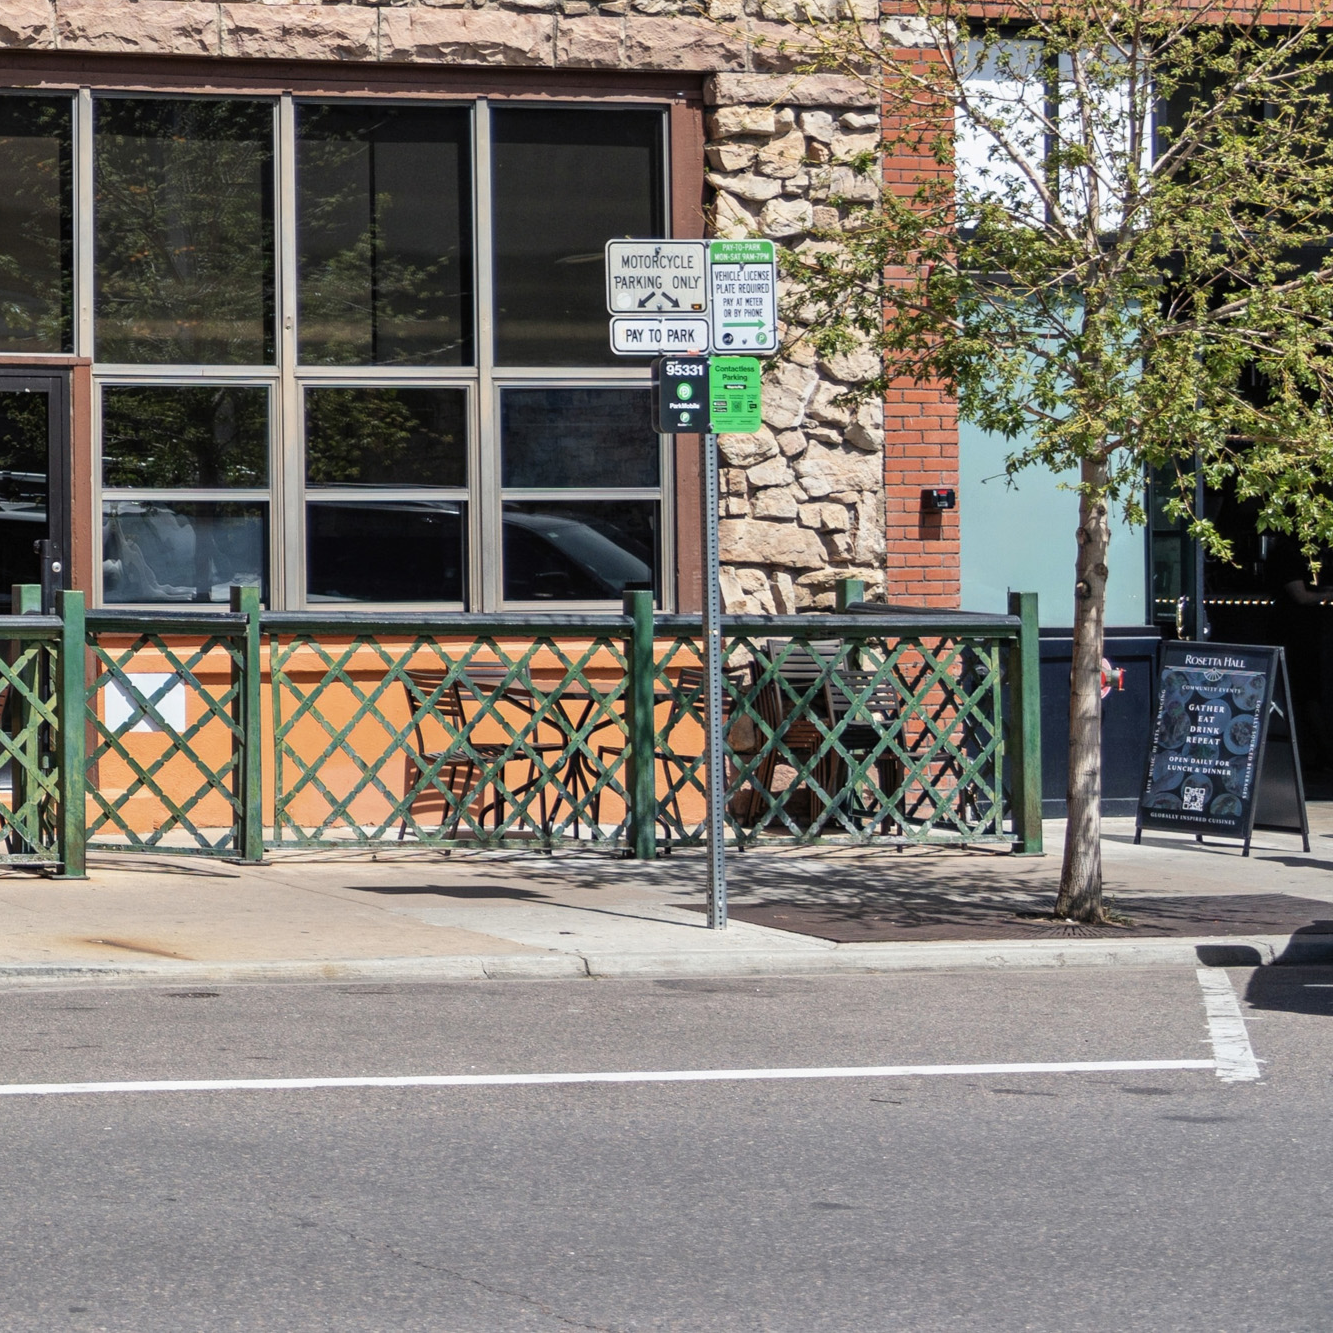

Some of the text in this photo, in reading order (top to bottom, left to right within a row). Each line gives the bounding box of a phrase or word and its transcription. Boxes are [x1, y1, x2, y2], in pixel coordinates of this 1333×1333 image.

[621, 255, 694, 269] MOTORCYCLE
[714, 270, 770, 282] VEHICLE LICENSE
[614, 276, 701, 290] PARKING ONLY
[716, 283, 770, 294] PLATE REQUIRED
[723, 298, 763, 307] PAY AT METER
[723, 309, 763, 318] OR BY PHONE
[625, 329, 695, 343] PAY TO PARK
[666, 364, 703, 376] 95331
[715, 365, 755, 373] Contactless
[722, 374, 748, 382] Parking
[1185, 654, 1246, 668] ROSETTA HALL
[1182, 684, 1217, 692] COMMUNITY
[1158, 689, 1166, 719] DANCING
[1188, 703, 1225, 713] GATHER
[1198, 715, 1215, 723] EAT
[1189, 725, 1220, 735] DRINK
[1185, 736, 1221, 746] REPEAT
[1242, 700, 1261, 799] LOCALLY SOURCED BEVERAGES
[1167, 764, 1193, 772] LUNCH
[1202, 768, 1232, 776] DINNER
[1150, 812, 1236, 826] GLOBALLY INSPIRED CUISINES
